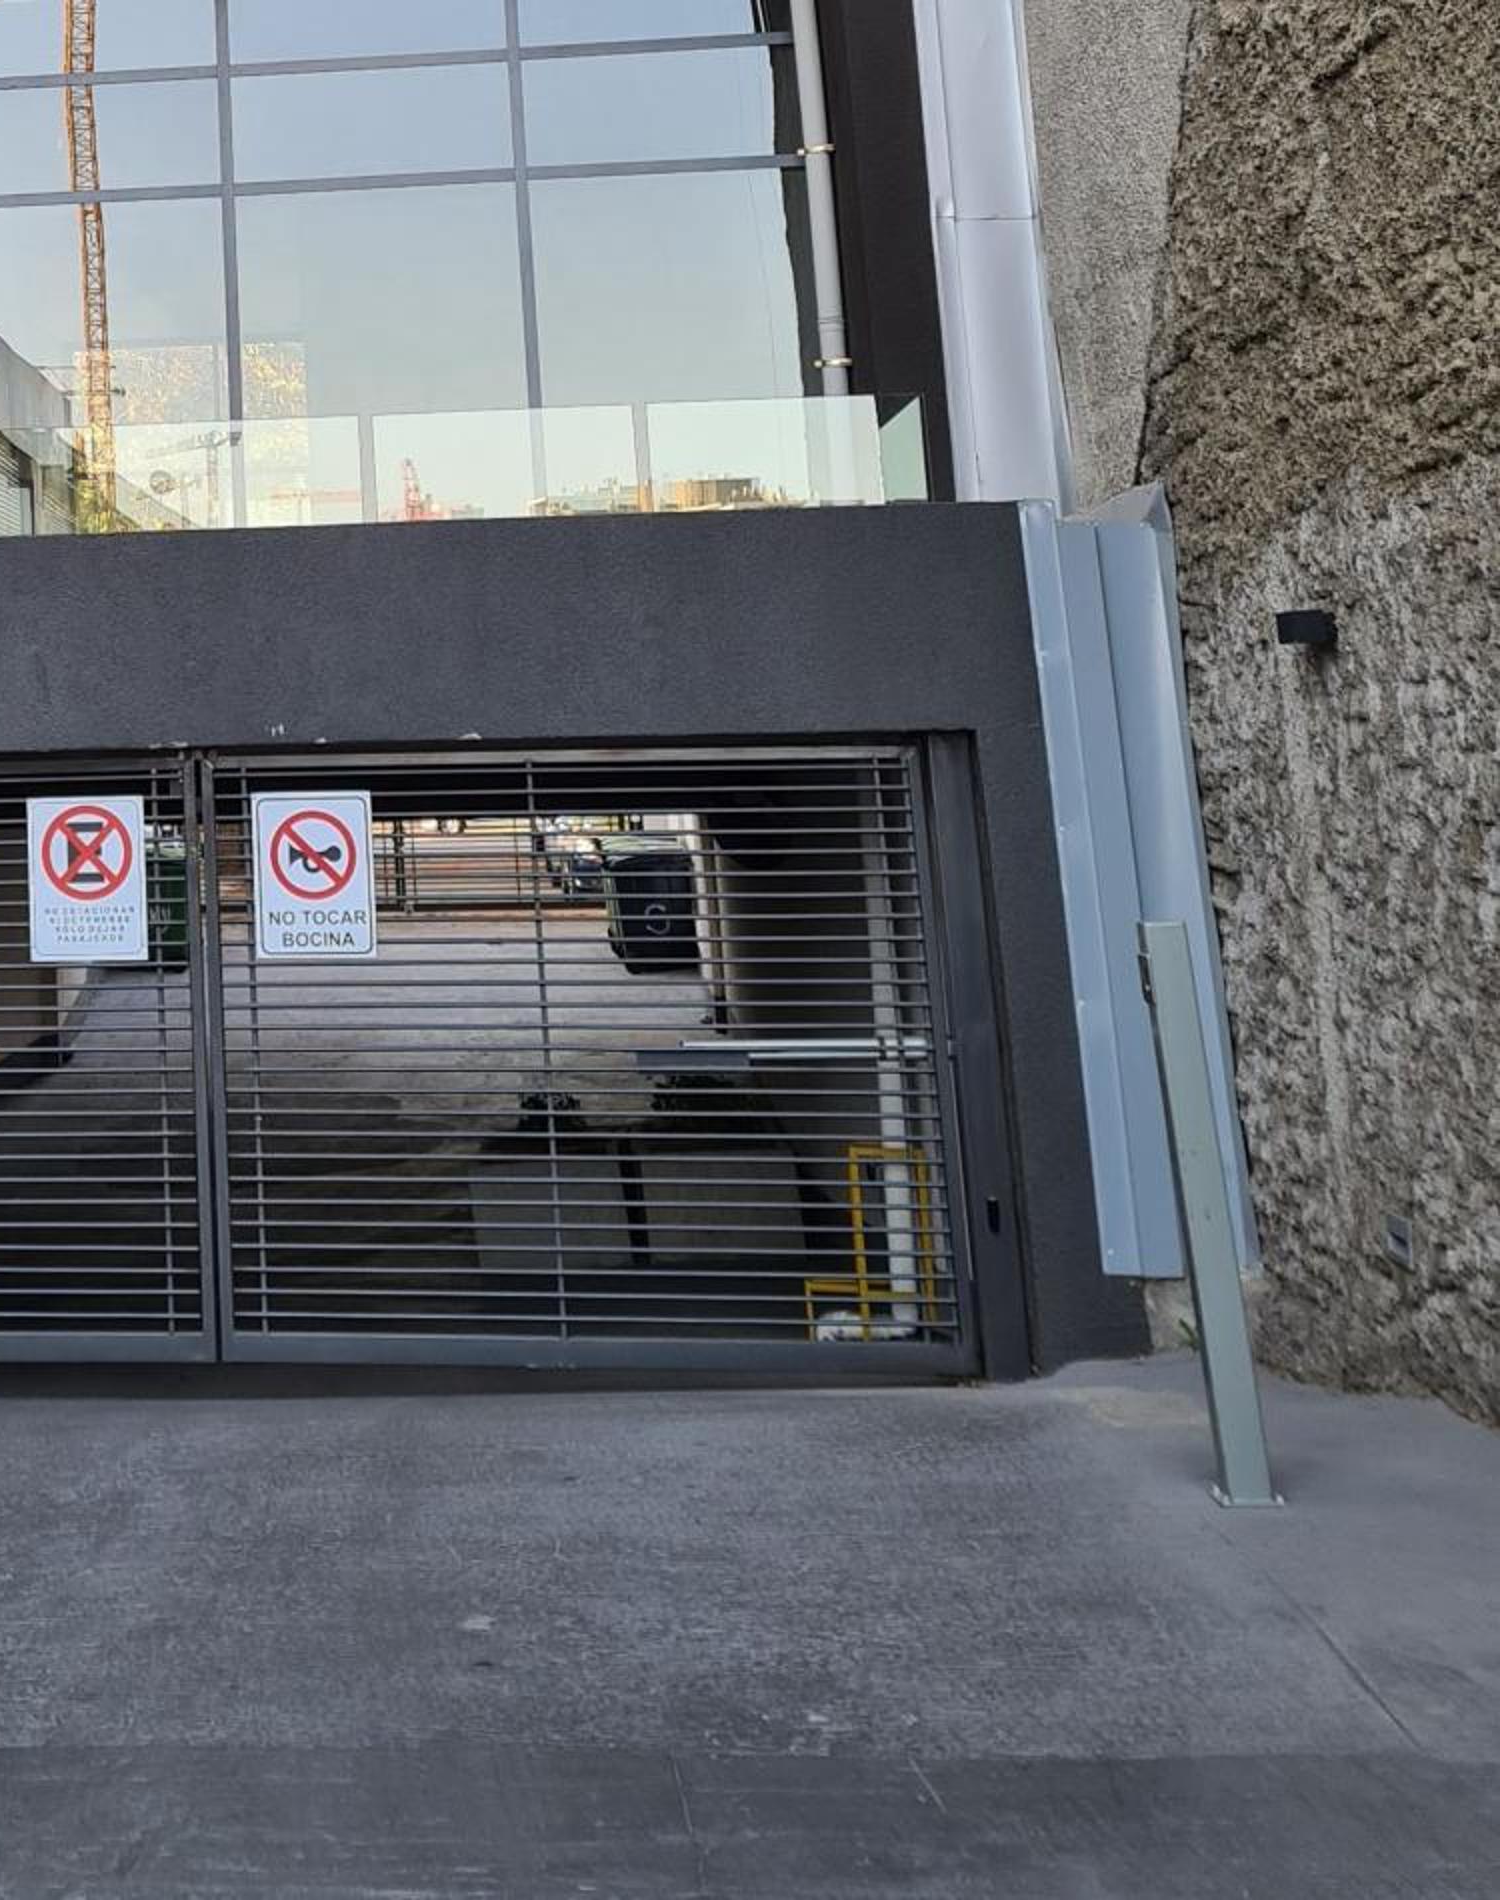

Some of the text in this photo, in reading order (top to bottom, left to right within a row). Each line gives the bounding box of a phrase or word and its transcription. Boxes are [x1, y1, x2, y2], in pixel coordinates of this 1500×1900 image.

[269, 909, 367, 926] NO TOCAR
[283, 931, 355, 947] BOCINA
